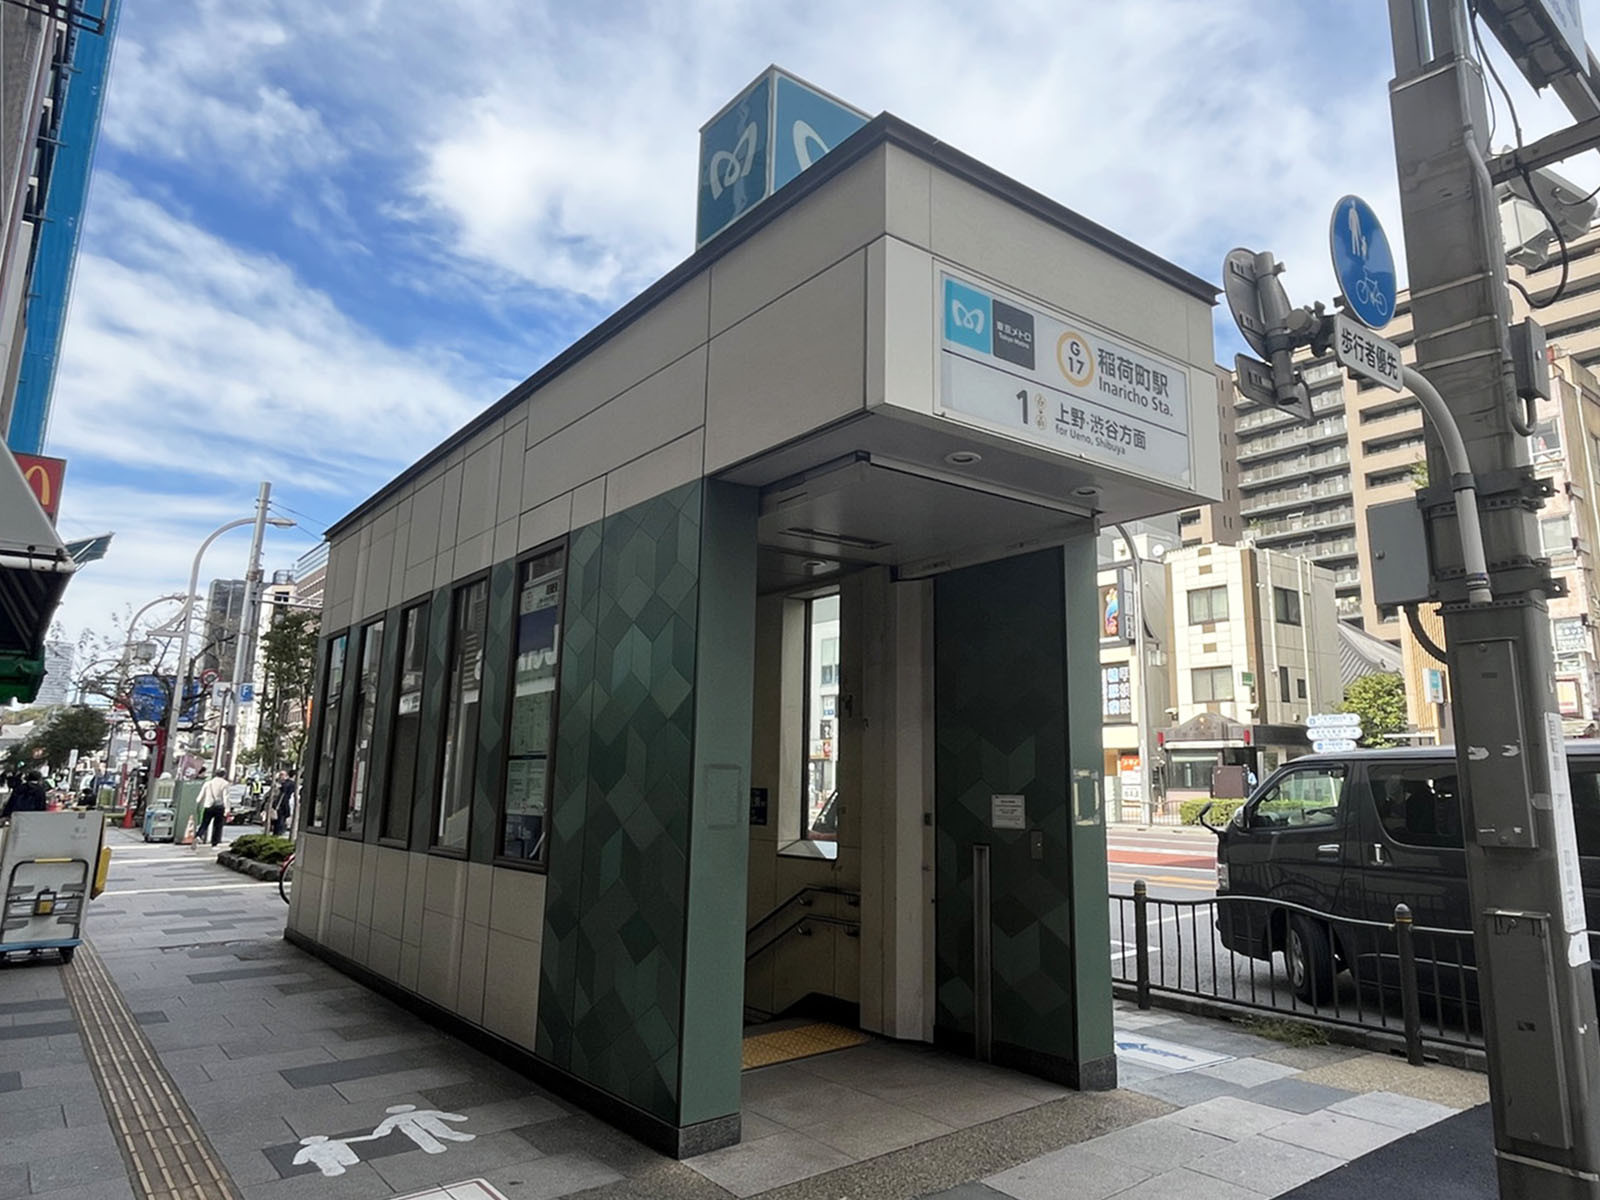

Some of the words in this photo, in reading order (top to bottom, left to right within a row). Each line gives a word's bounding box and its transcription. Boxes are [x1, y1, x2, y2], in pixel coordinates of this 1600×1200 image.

[1068, 356, 1085, 375] 17
[1070, 341, 1080, 356] G
[1341, 328, 1399, 380] 歩行者優先
[1098, 348, 1169, 398] 稲荷町駅
[1015, 389, 1029, 425] 1
[1098, 376, 1149, 407] Inaricho
[1151, 396, 1174, 417] Sta.
[1055, 424, 1068, 436] for
[1095, 436, 1126, 456] Shibuya
